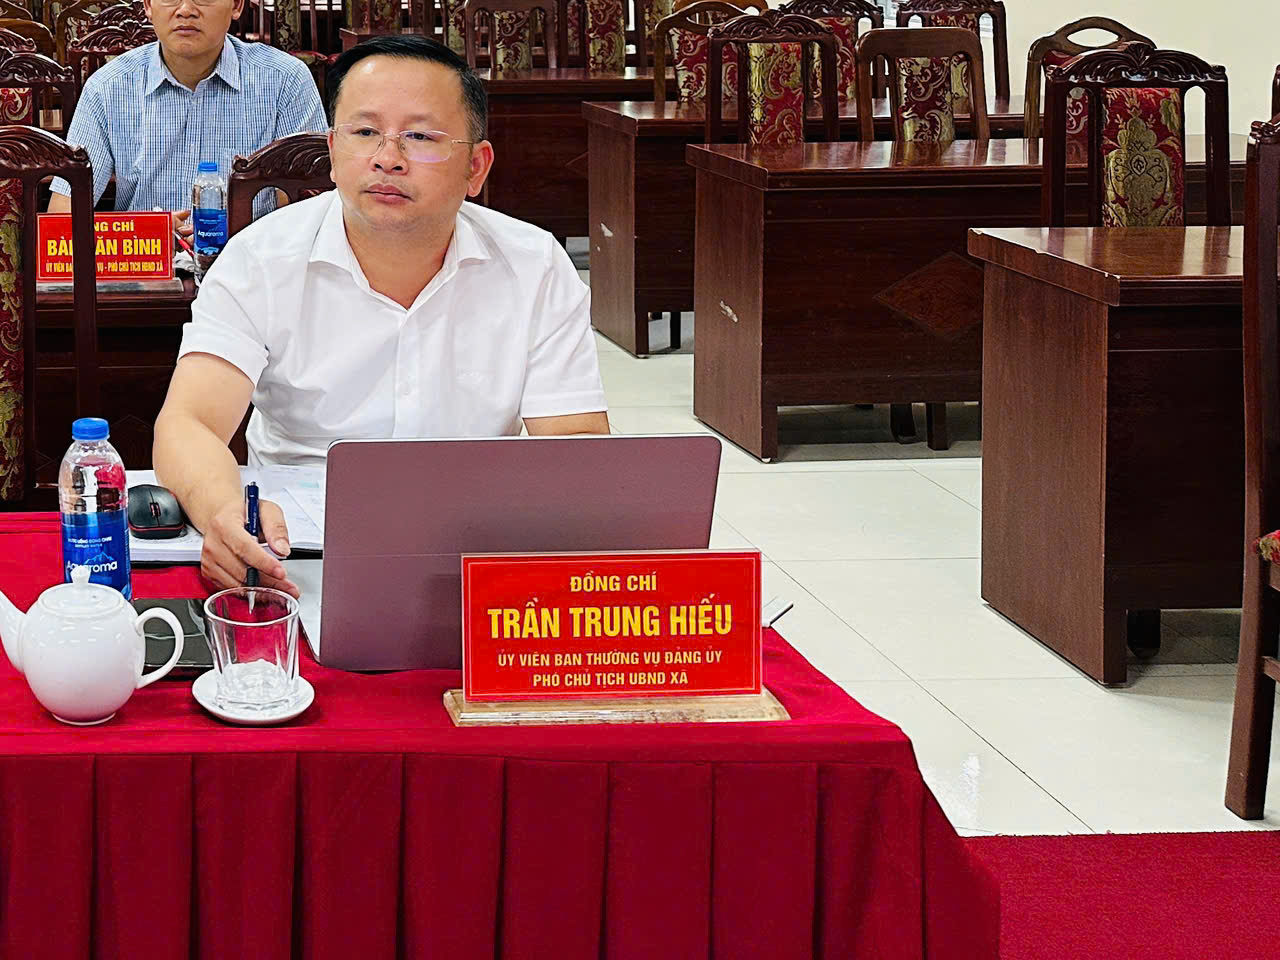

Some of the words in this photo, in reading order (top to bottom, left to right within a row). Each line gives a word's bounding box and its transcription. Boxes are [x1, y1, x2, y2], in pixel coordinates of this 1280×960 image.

[94, 221, 109, 232] NG
[112, 220, 135, 232] CHÍ
[47, 235, 73, 256] BÀ
[95, 235, 118, 255] ĂN
[122, 235, 161, 256] BÌNH
[570, 570, 620, 592] ĐỒNG
[627, 571, 657, 591] CHÍ
[488, 597, 560, 638] TRẦN
[569, 606, 660, 638] TRUNG
[670, 593, 732, 635] HIẾU
[498, 649, 515, 667] ỦY
[520, 651, 550, 667] VIÊN
[555, 653, 582, 667] BAN
[586, 648, 640, 666] THƯỜNG
[644, 651, 661, 668] VỤ
[665, 647, 702, 665] ĐẢNG
[706, 646, 722, 663] ỦY
[565, 669, 591, 687] CHỦ
[595, 672, 625, 689] TỊCH
[629, 672, 666, 685] UBND
[670, 669, 689, 684] XÃ
